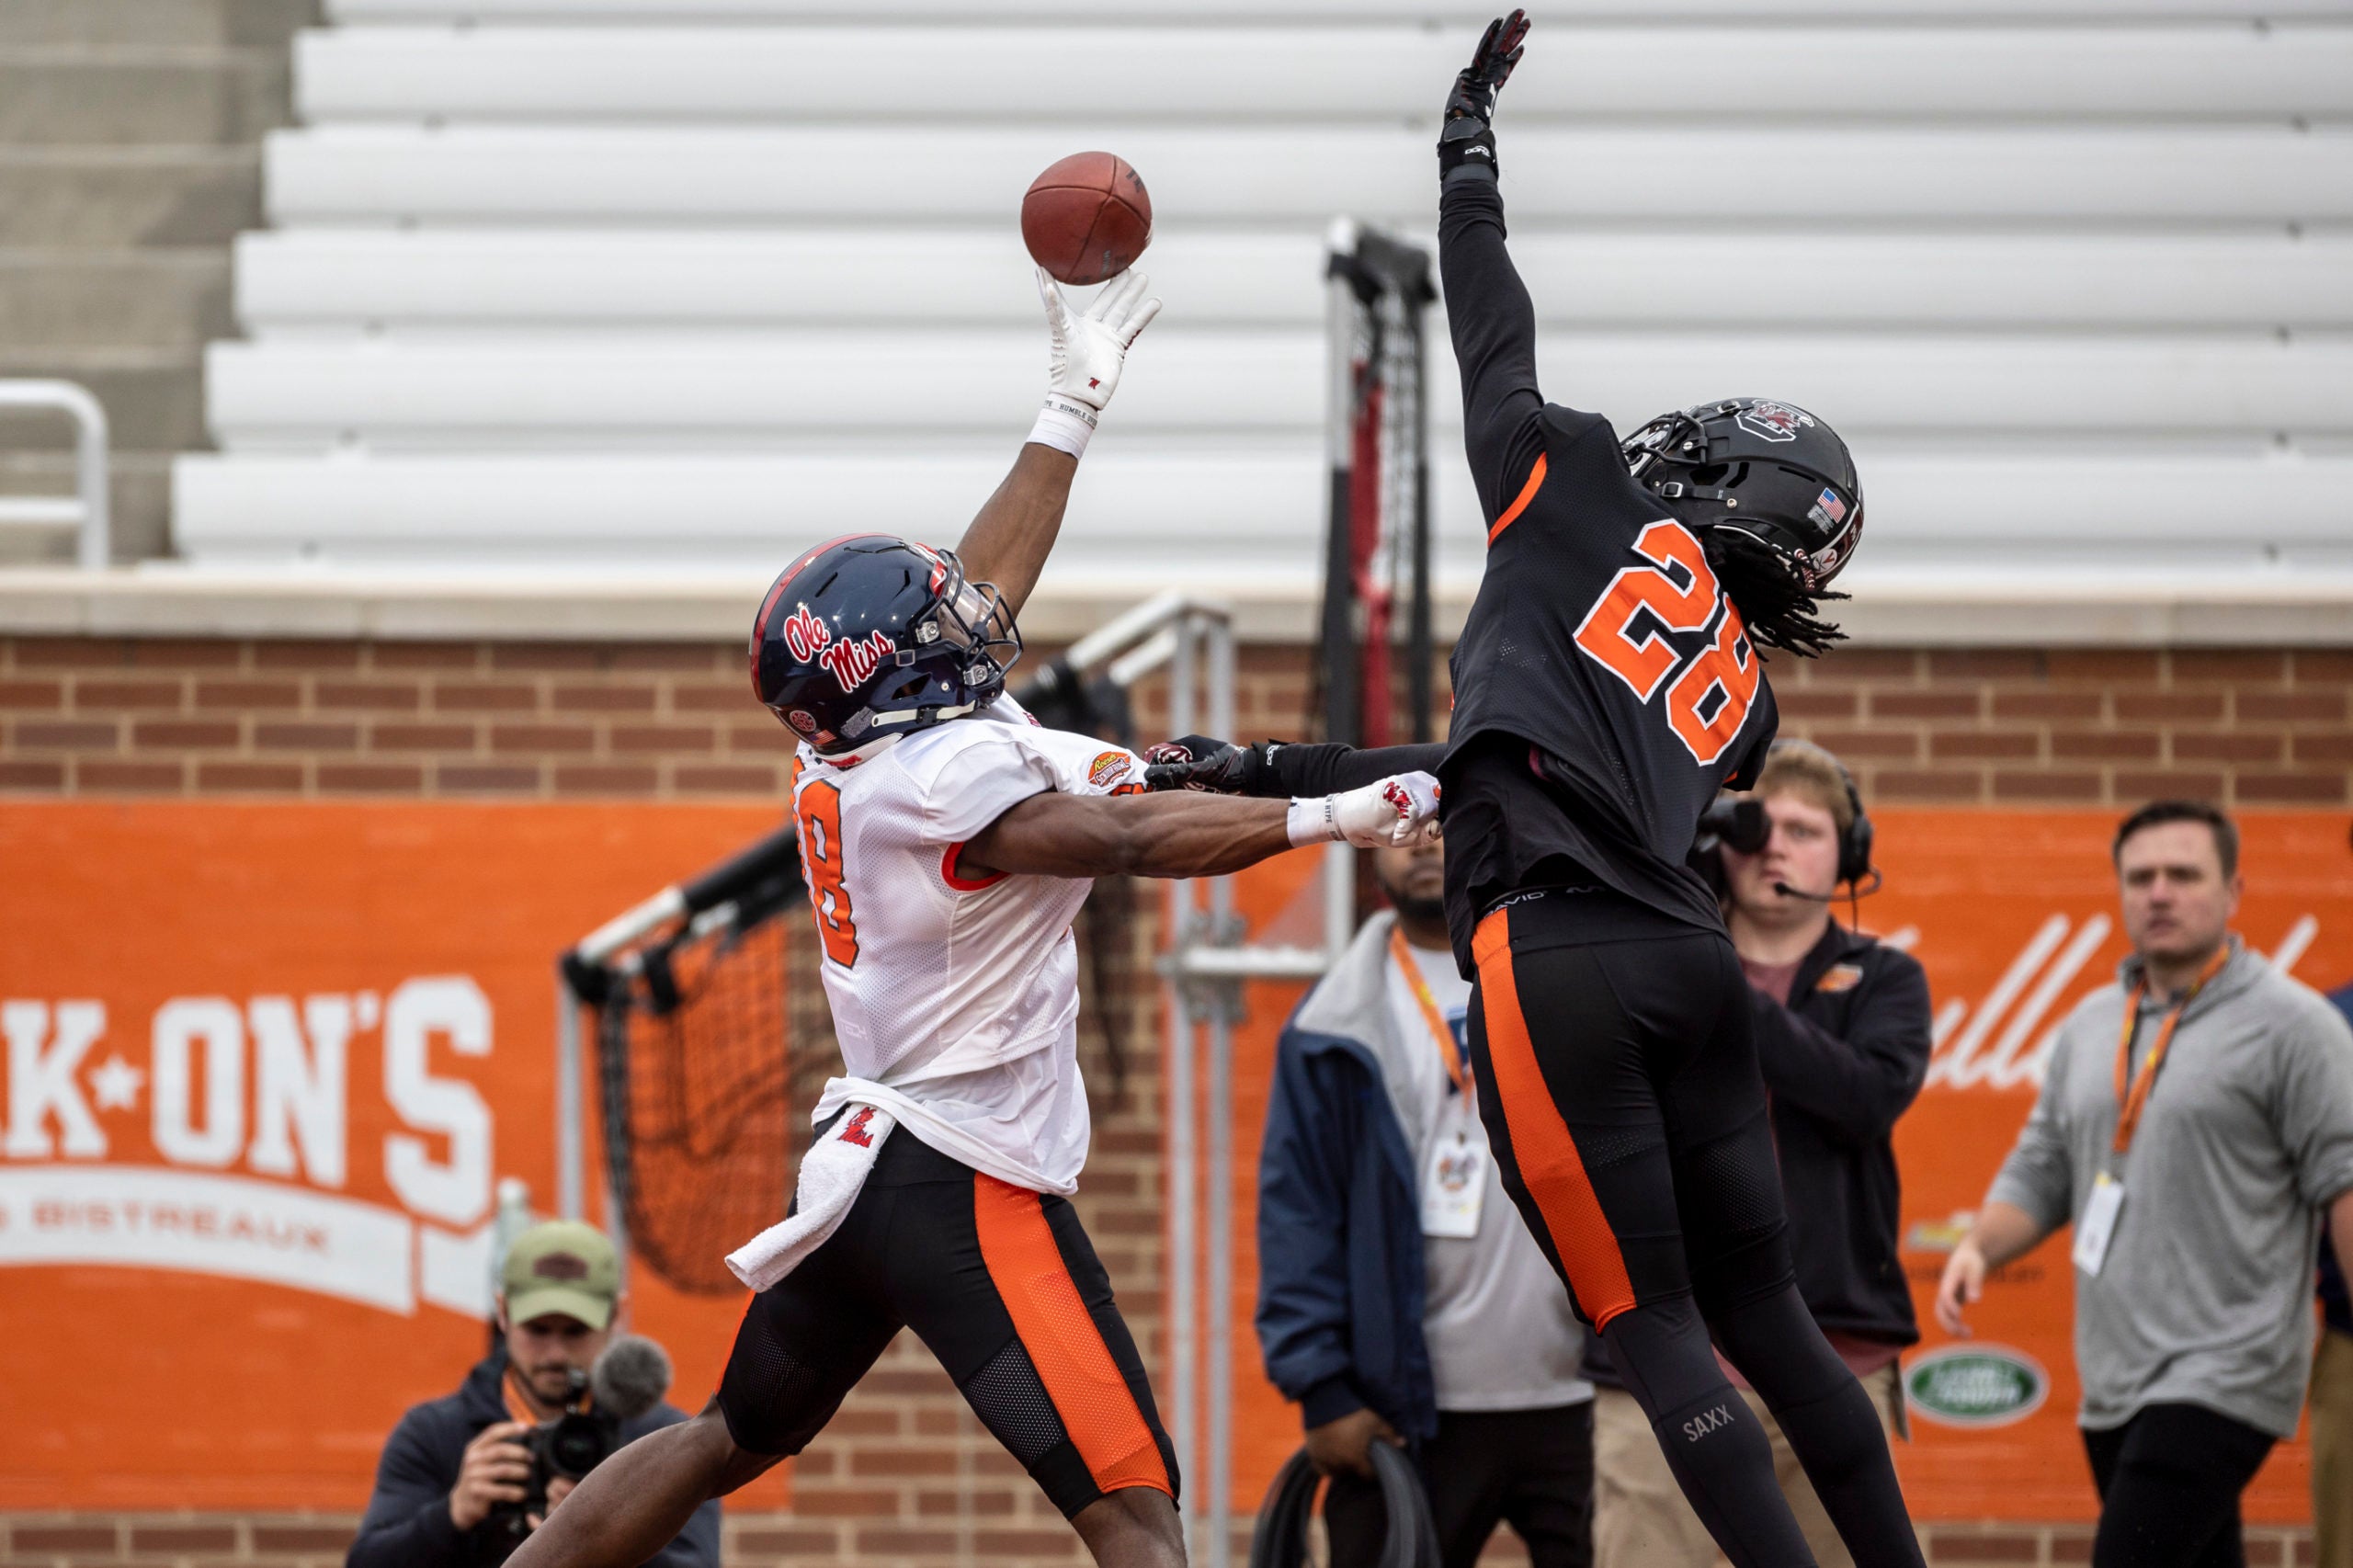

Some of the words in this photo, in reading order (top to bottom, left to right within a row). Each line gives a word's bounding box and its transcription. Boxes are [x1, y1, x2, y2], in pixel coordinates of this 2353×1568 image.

[1059, 403, 1086, 419] HUMBLE
[784, 607, 831, 663] Ole
[820, 630, 896, 693] Miss
[1572, 517, 1759, 767] 28
[31, 1198, 332, 1256] BISTREAUX
[1683, 1403, 1735, 1442] SAXX
